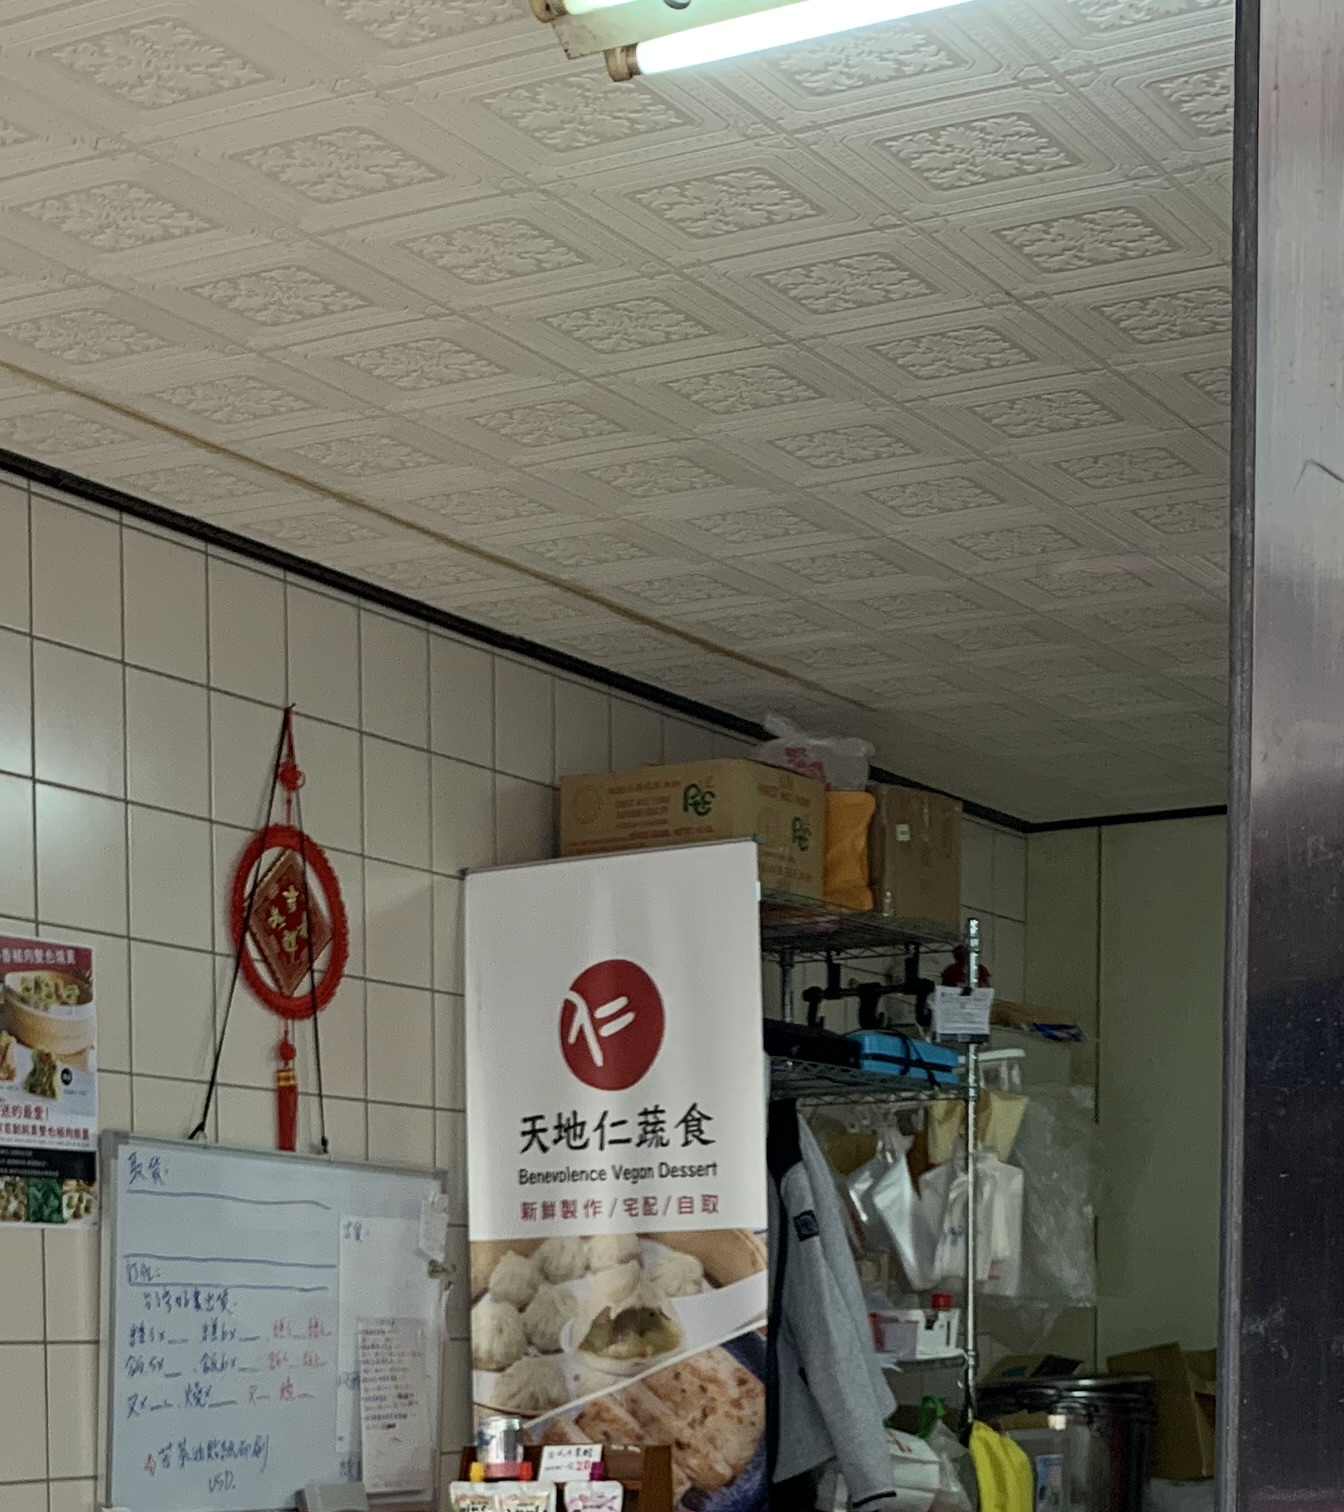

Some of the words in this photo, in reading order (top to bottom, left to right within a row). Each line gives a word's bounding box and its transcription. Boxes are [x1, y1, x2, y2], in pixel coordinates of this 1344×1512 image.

[519, 1102, 717, 1155] 天地仁蔬食
[518, 1164, 607, 1185] Benevolence
[611, 1163, 655, 1184] Vegan
[658, 1160, 718, 1180] Dessert
